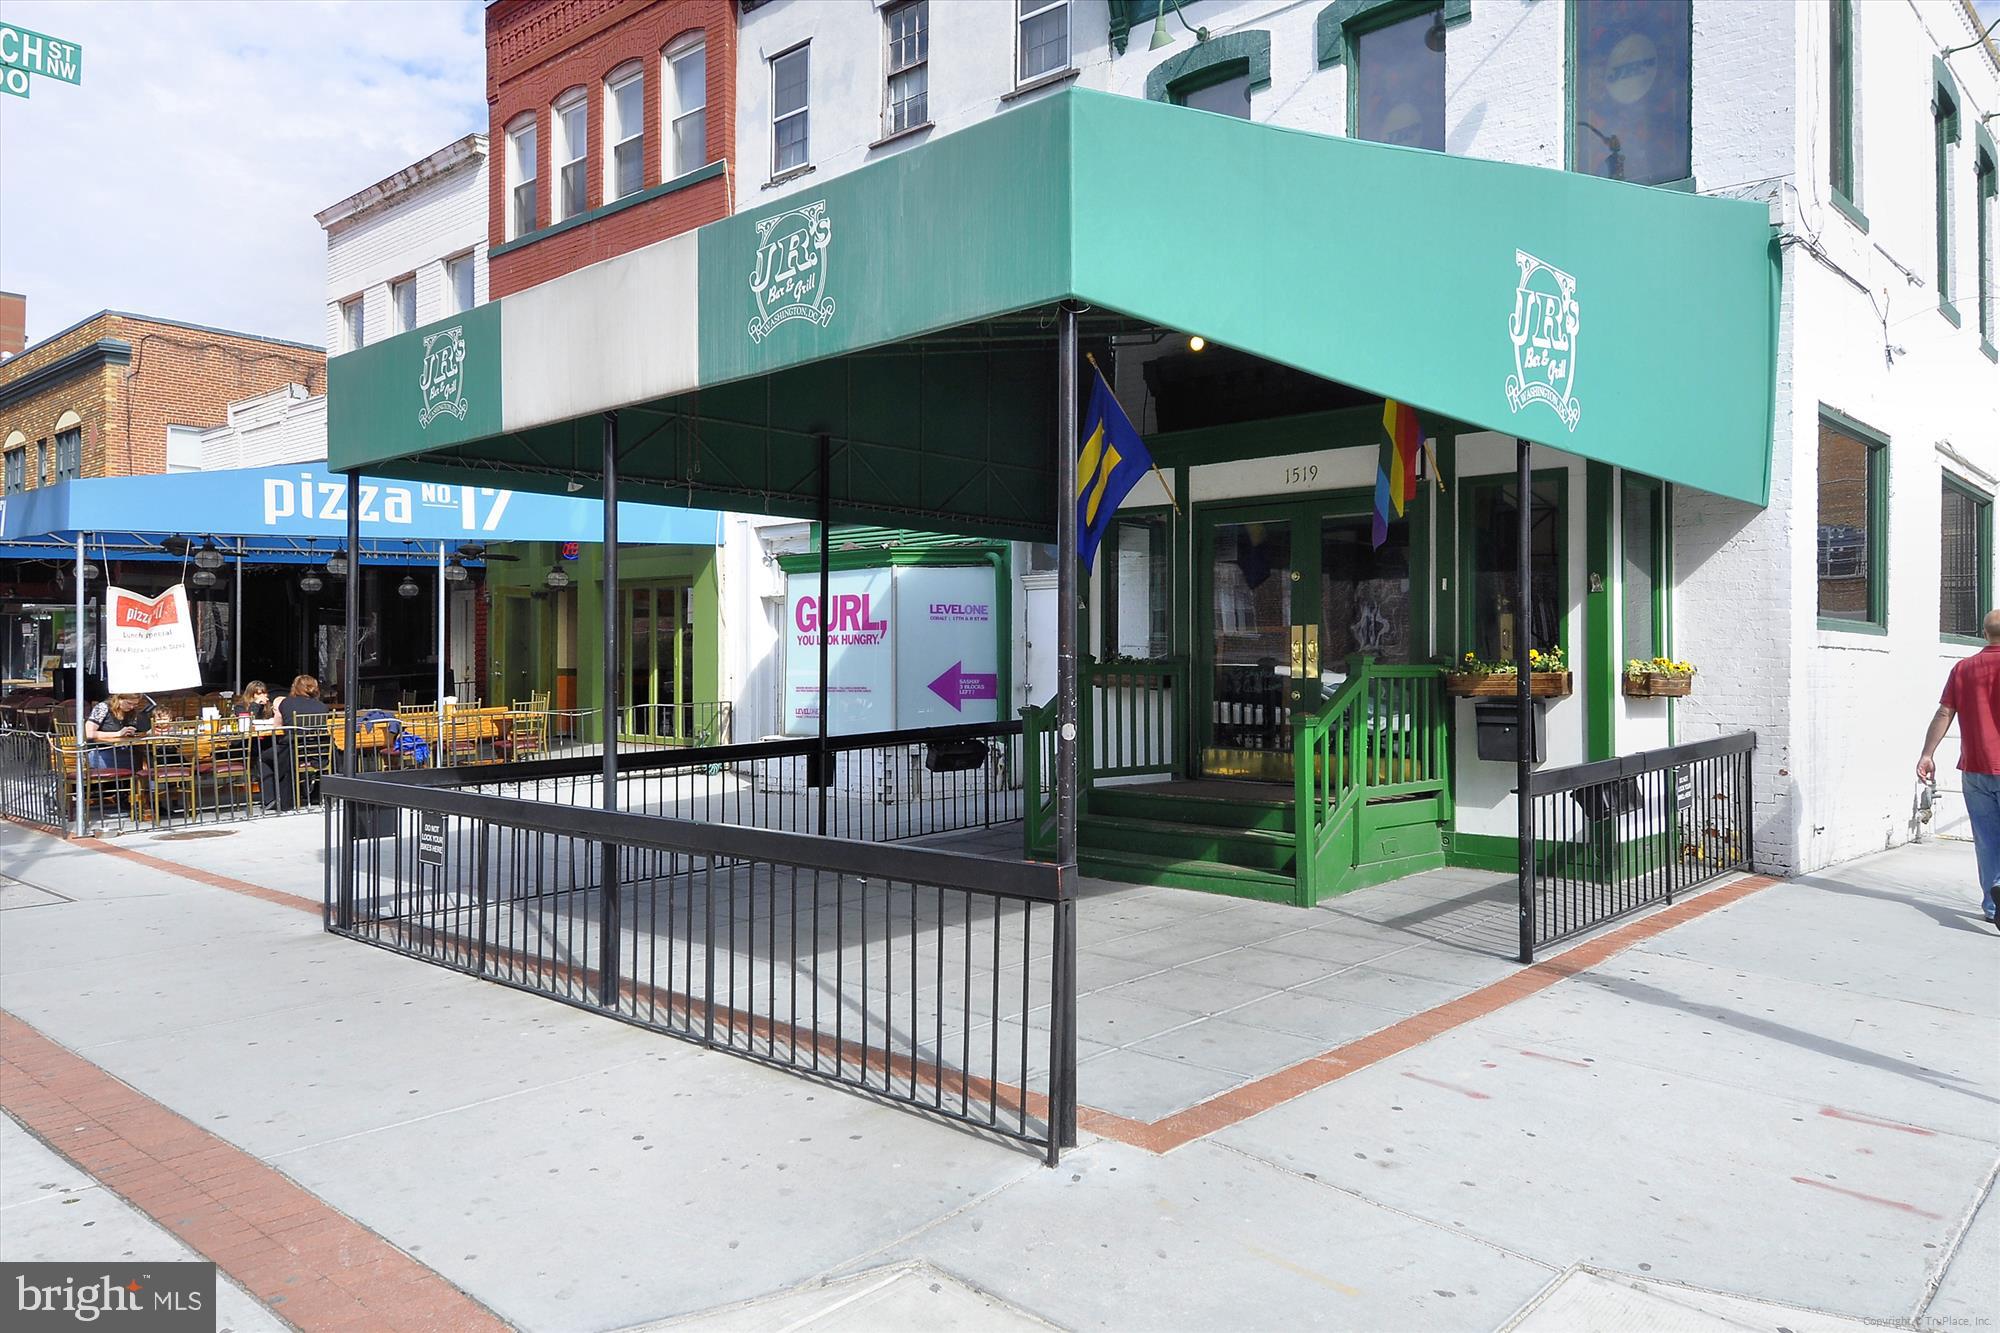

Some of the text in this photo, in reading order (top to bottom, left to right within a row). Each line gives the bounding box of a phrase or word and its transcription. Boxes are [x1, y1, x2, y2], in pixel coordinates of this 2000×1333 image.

[48, 41, 75, 62] ST
[47, 57, 76, 80] NW
[0, 68, 29, 93] 0
[767, 272, 815, 305] Bar & Grill
[1286, 465, 1318, 484] 1519
[263, 472, 512, 531] pizza NO. 17
[795, 593, 887, 639] GURL,
[929, 604, 988, 615] LEVELONE
[796, 633, 880, 646] YOU LOK HUNGRY.
[421, 833, 443, 844] LOCK YOUR
[424, 823, 440, 833] DO NOT
